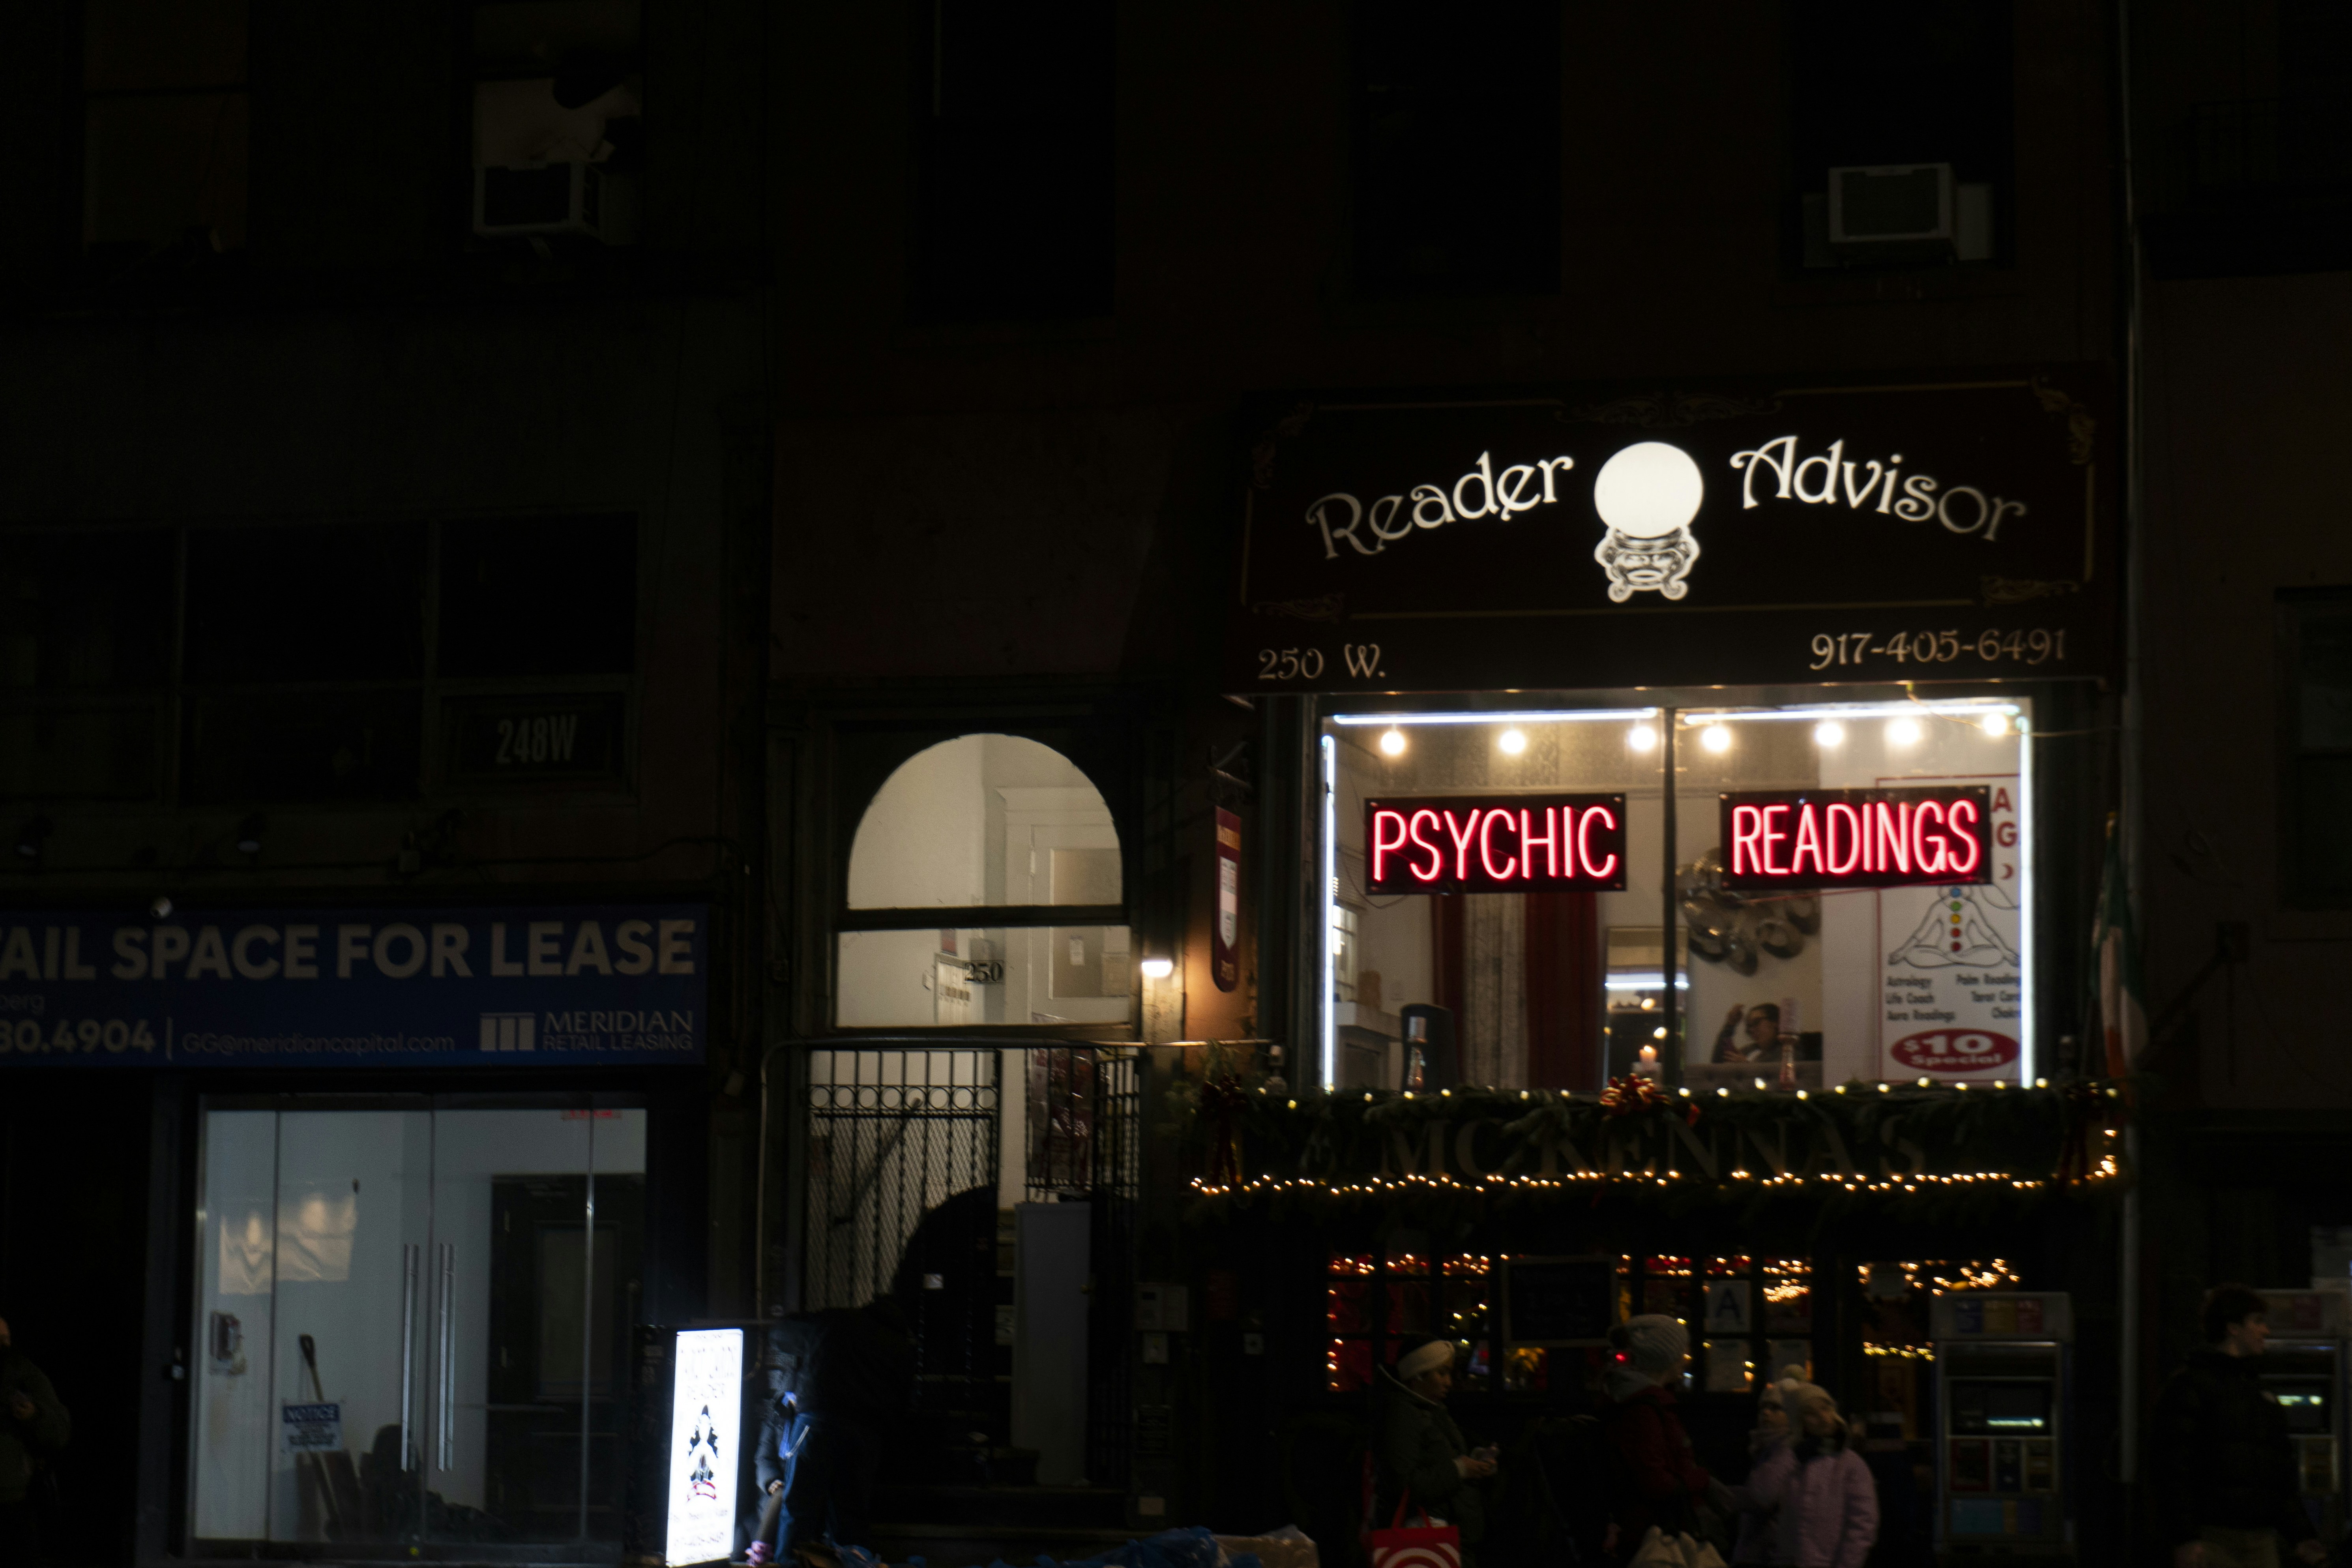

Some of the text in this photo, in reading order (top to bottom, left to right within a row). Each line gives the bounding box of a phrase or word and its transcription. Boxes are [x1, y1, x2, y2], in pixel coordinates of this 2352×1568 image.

[1304, 434, 2028, 561] Reader Advisor
[1257, 643, 1386, 680] 250 W.
[1809, 628, 2067, 671] 917-405-6491
[494, 714, 578, 765] 248W
[1372, 798, 1982, 882] PSYCHIC READINGS
[0, 918, 697, 981] AIL SPACE FOR LEASE
[964, 961, 1004, 982] 250
[542, 1010, 695, 1034] MERIDIAN
[542, 1033, 695, 1053] RETAIL LEASING
[1903, 1034, 1993, 1055] $10
[1911, 1053, 2002, 1067] Special
[1715, 1288, 1741, 1318] A
